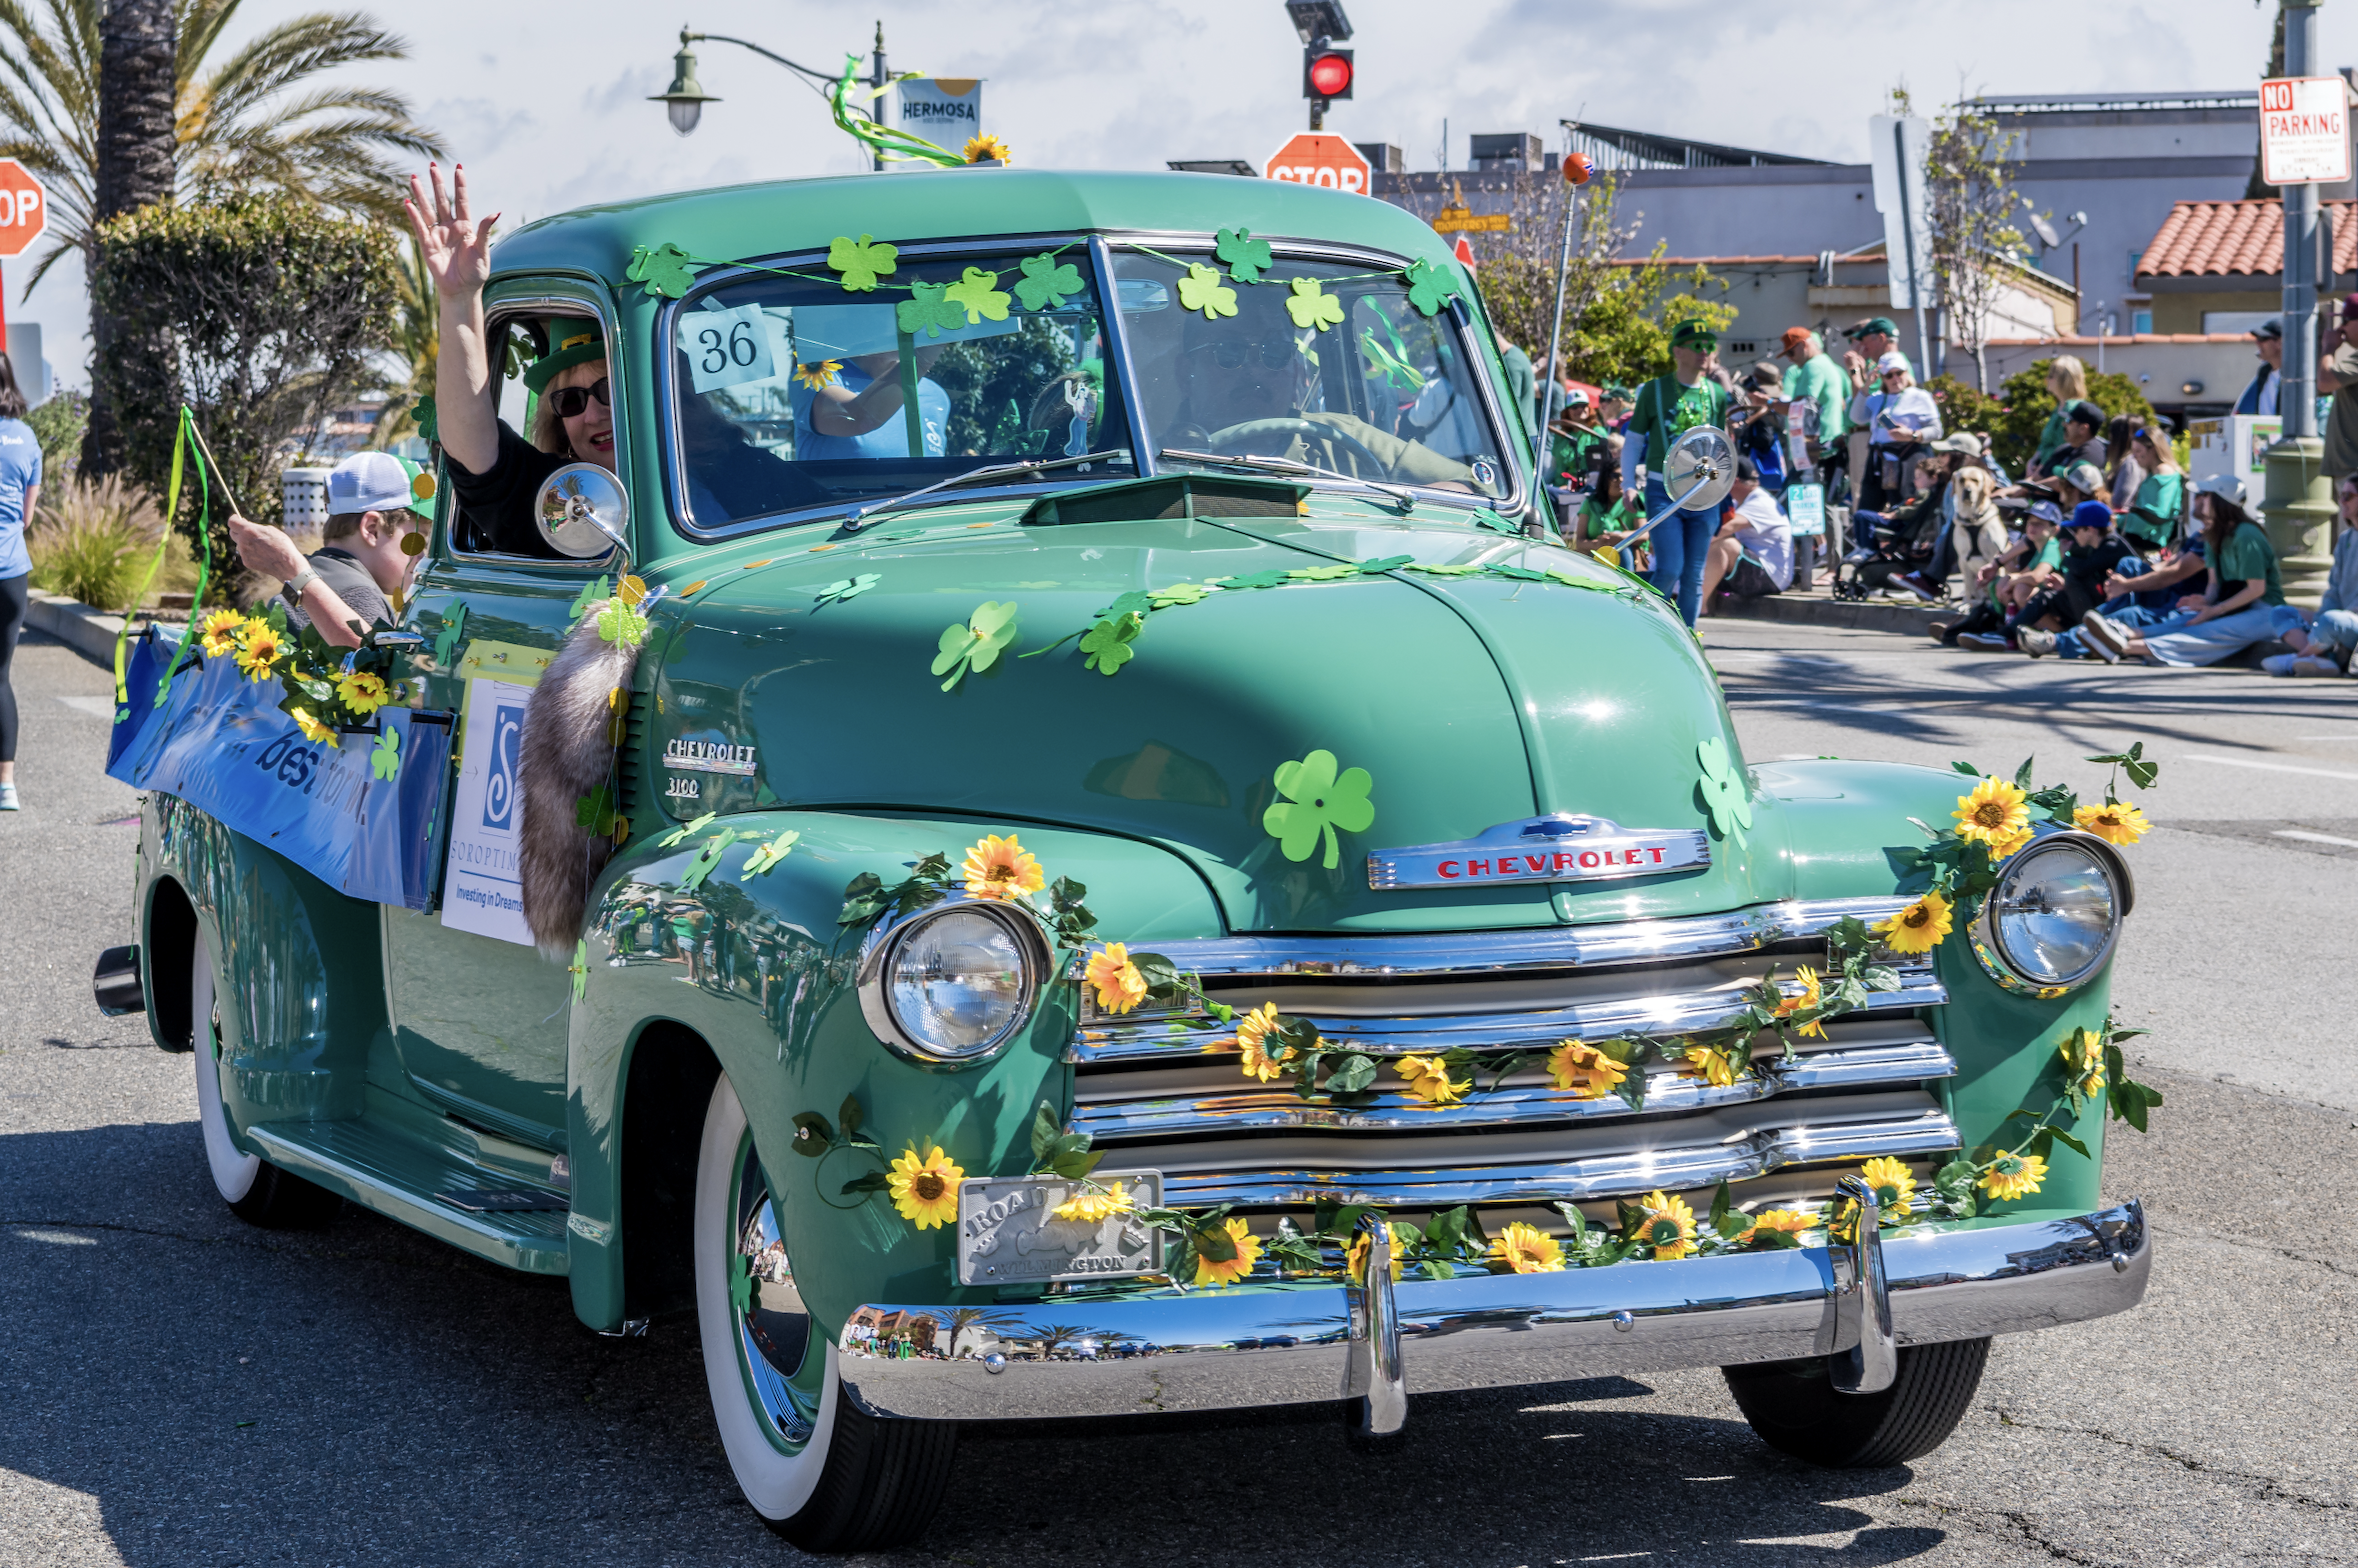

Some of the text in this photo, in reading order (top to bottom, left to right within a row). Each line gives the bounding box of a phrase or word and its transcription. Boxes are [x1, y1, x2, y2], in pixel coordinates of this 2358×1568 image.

[2264, 84, 2290, 110] NO
[903, 102, 975, 121] HERMOSA
[2270, 113, 2339, 136] PARKING
[0, 189, 39, 227] OP
[698, 321, 757, 374] 36
[1793, 488, 1801, 500] 2
[667, 738, 756, 763] CHEVROLET
[668, 777, 698, 795] 3100
[1437, 847, 1667, 880] CHEVROLET
[456, 883, 523, 912] Investing in Dreams
[967, 1186, 1051, 1235] ROAD
[995, 1254, 1127, 1275] WILMINGTON
